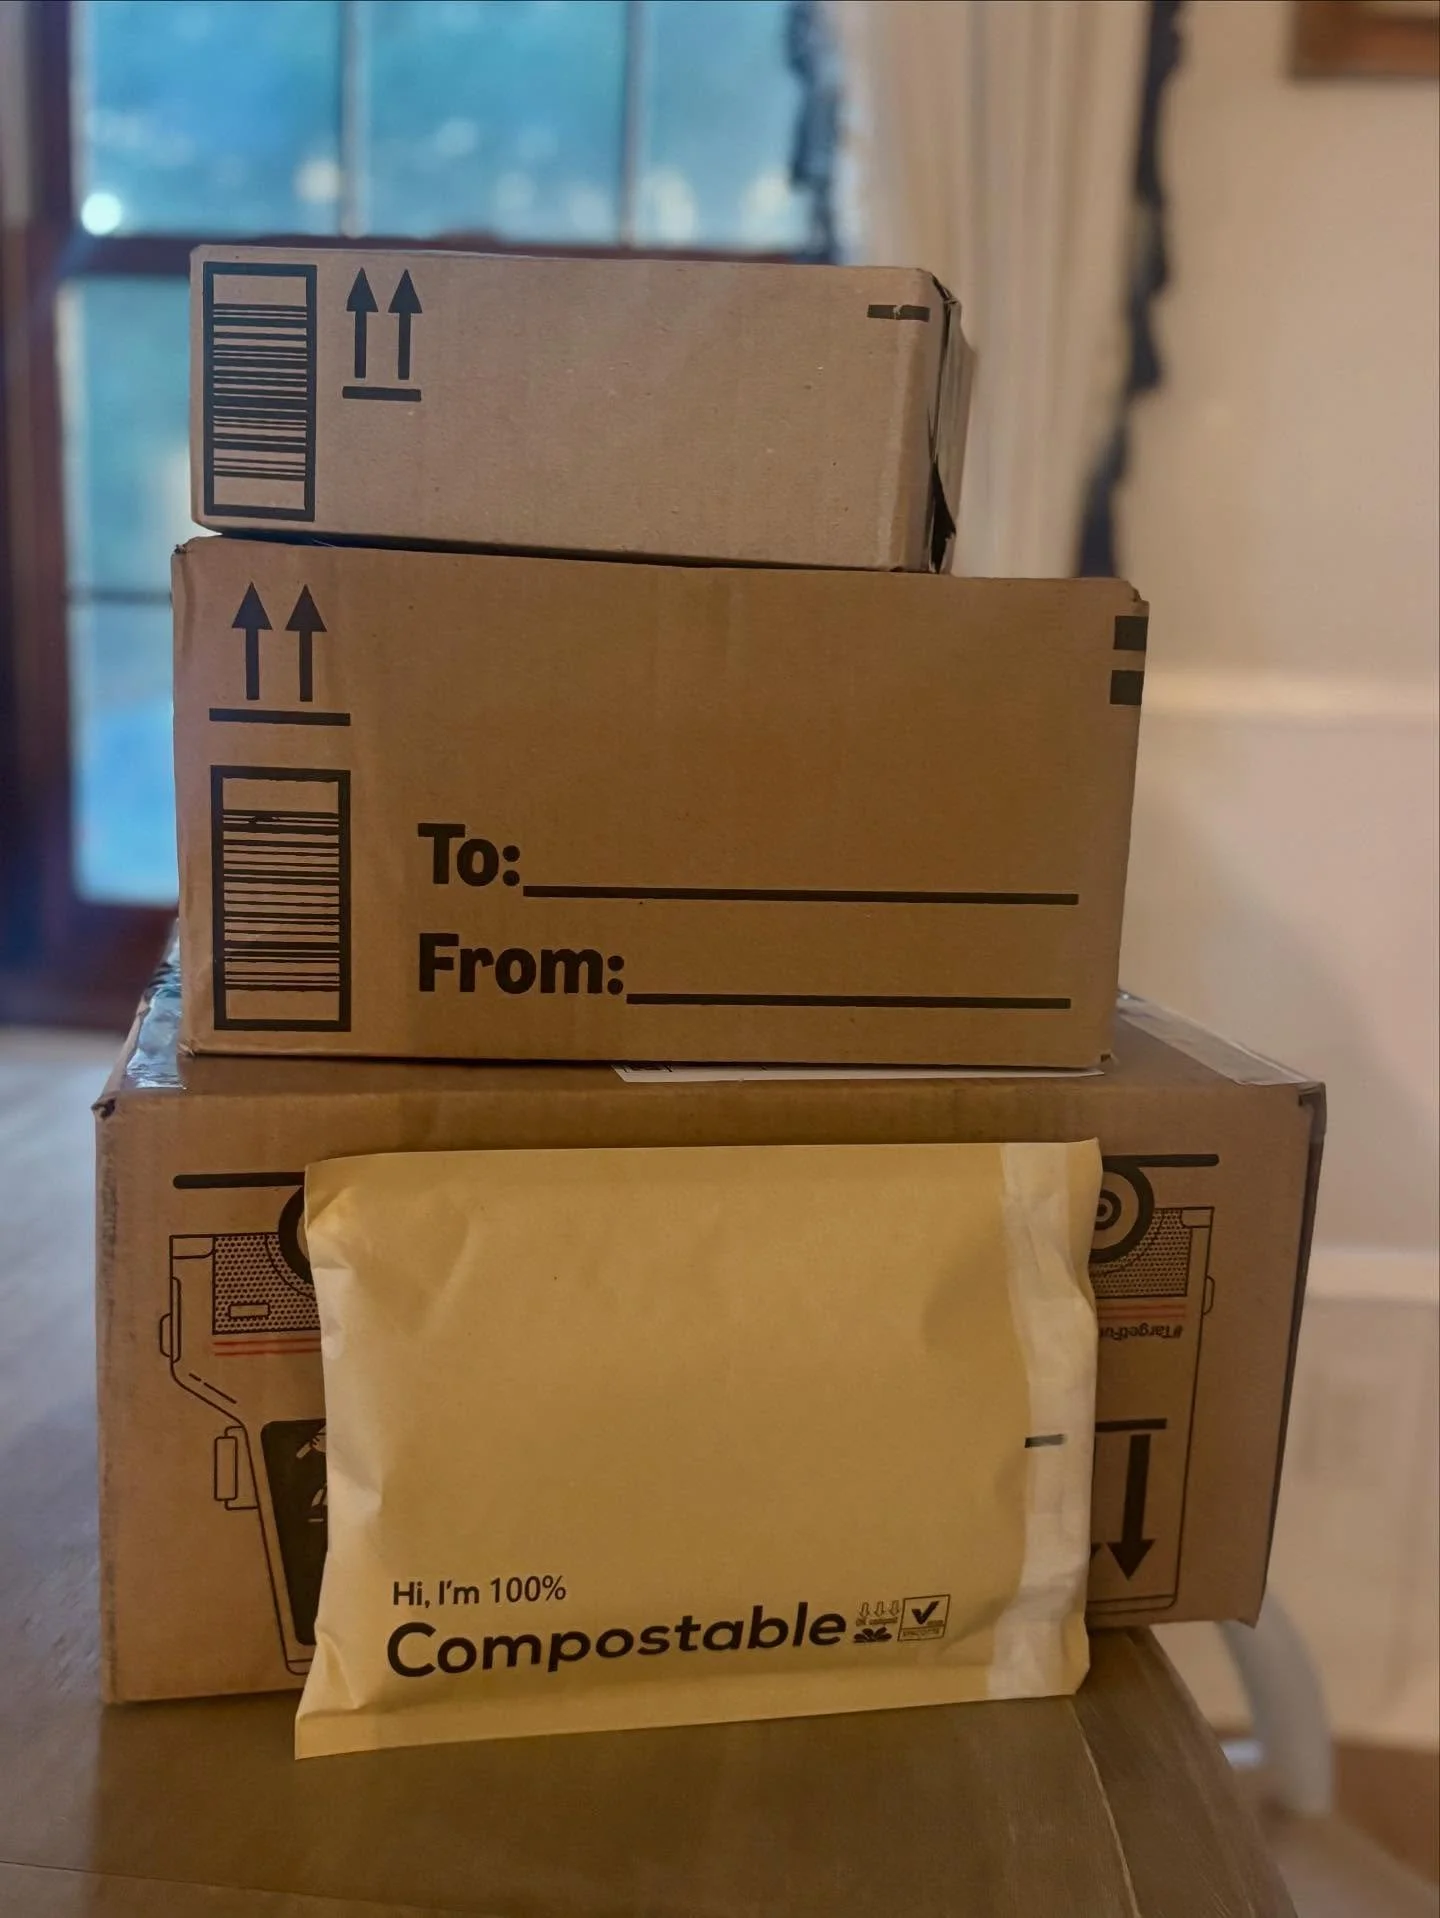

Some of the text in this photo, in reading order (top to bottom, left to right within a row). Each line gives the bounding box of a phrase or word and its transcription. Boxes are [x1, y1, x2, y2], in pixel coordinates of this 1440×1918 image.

[417, 822, 520, 887] To:
[418, 932, 625, 995] From:
[393, 1575, 567, 1608] Hi, I'm 100%
[387, 1601, 846, 1678] Compostable
